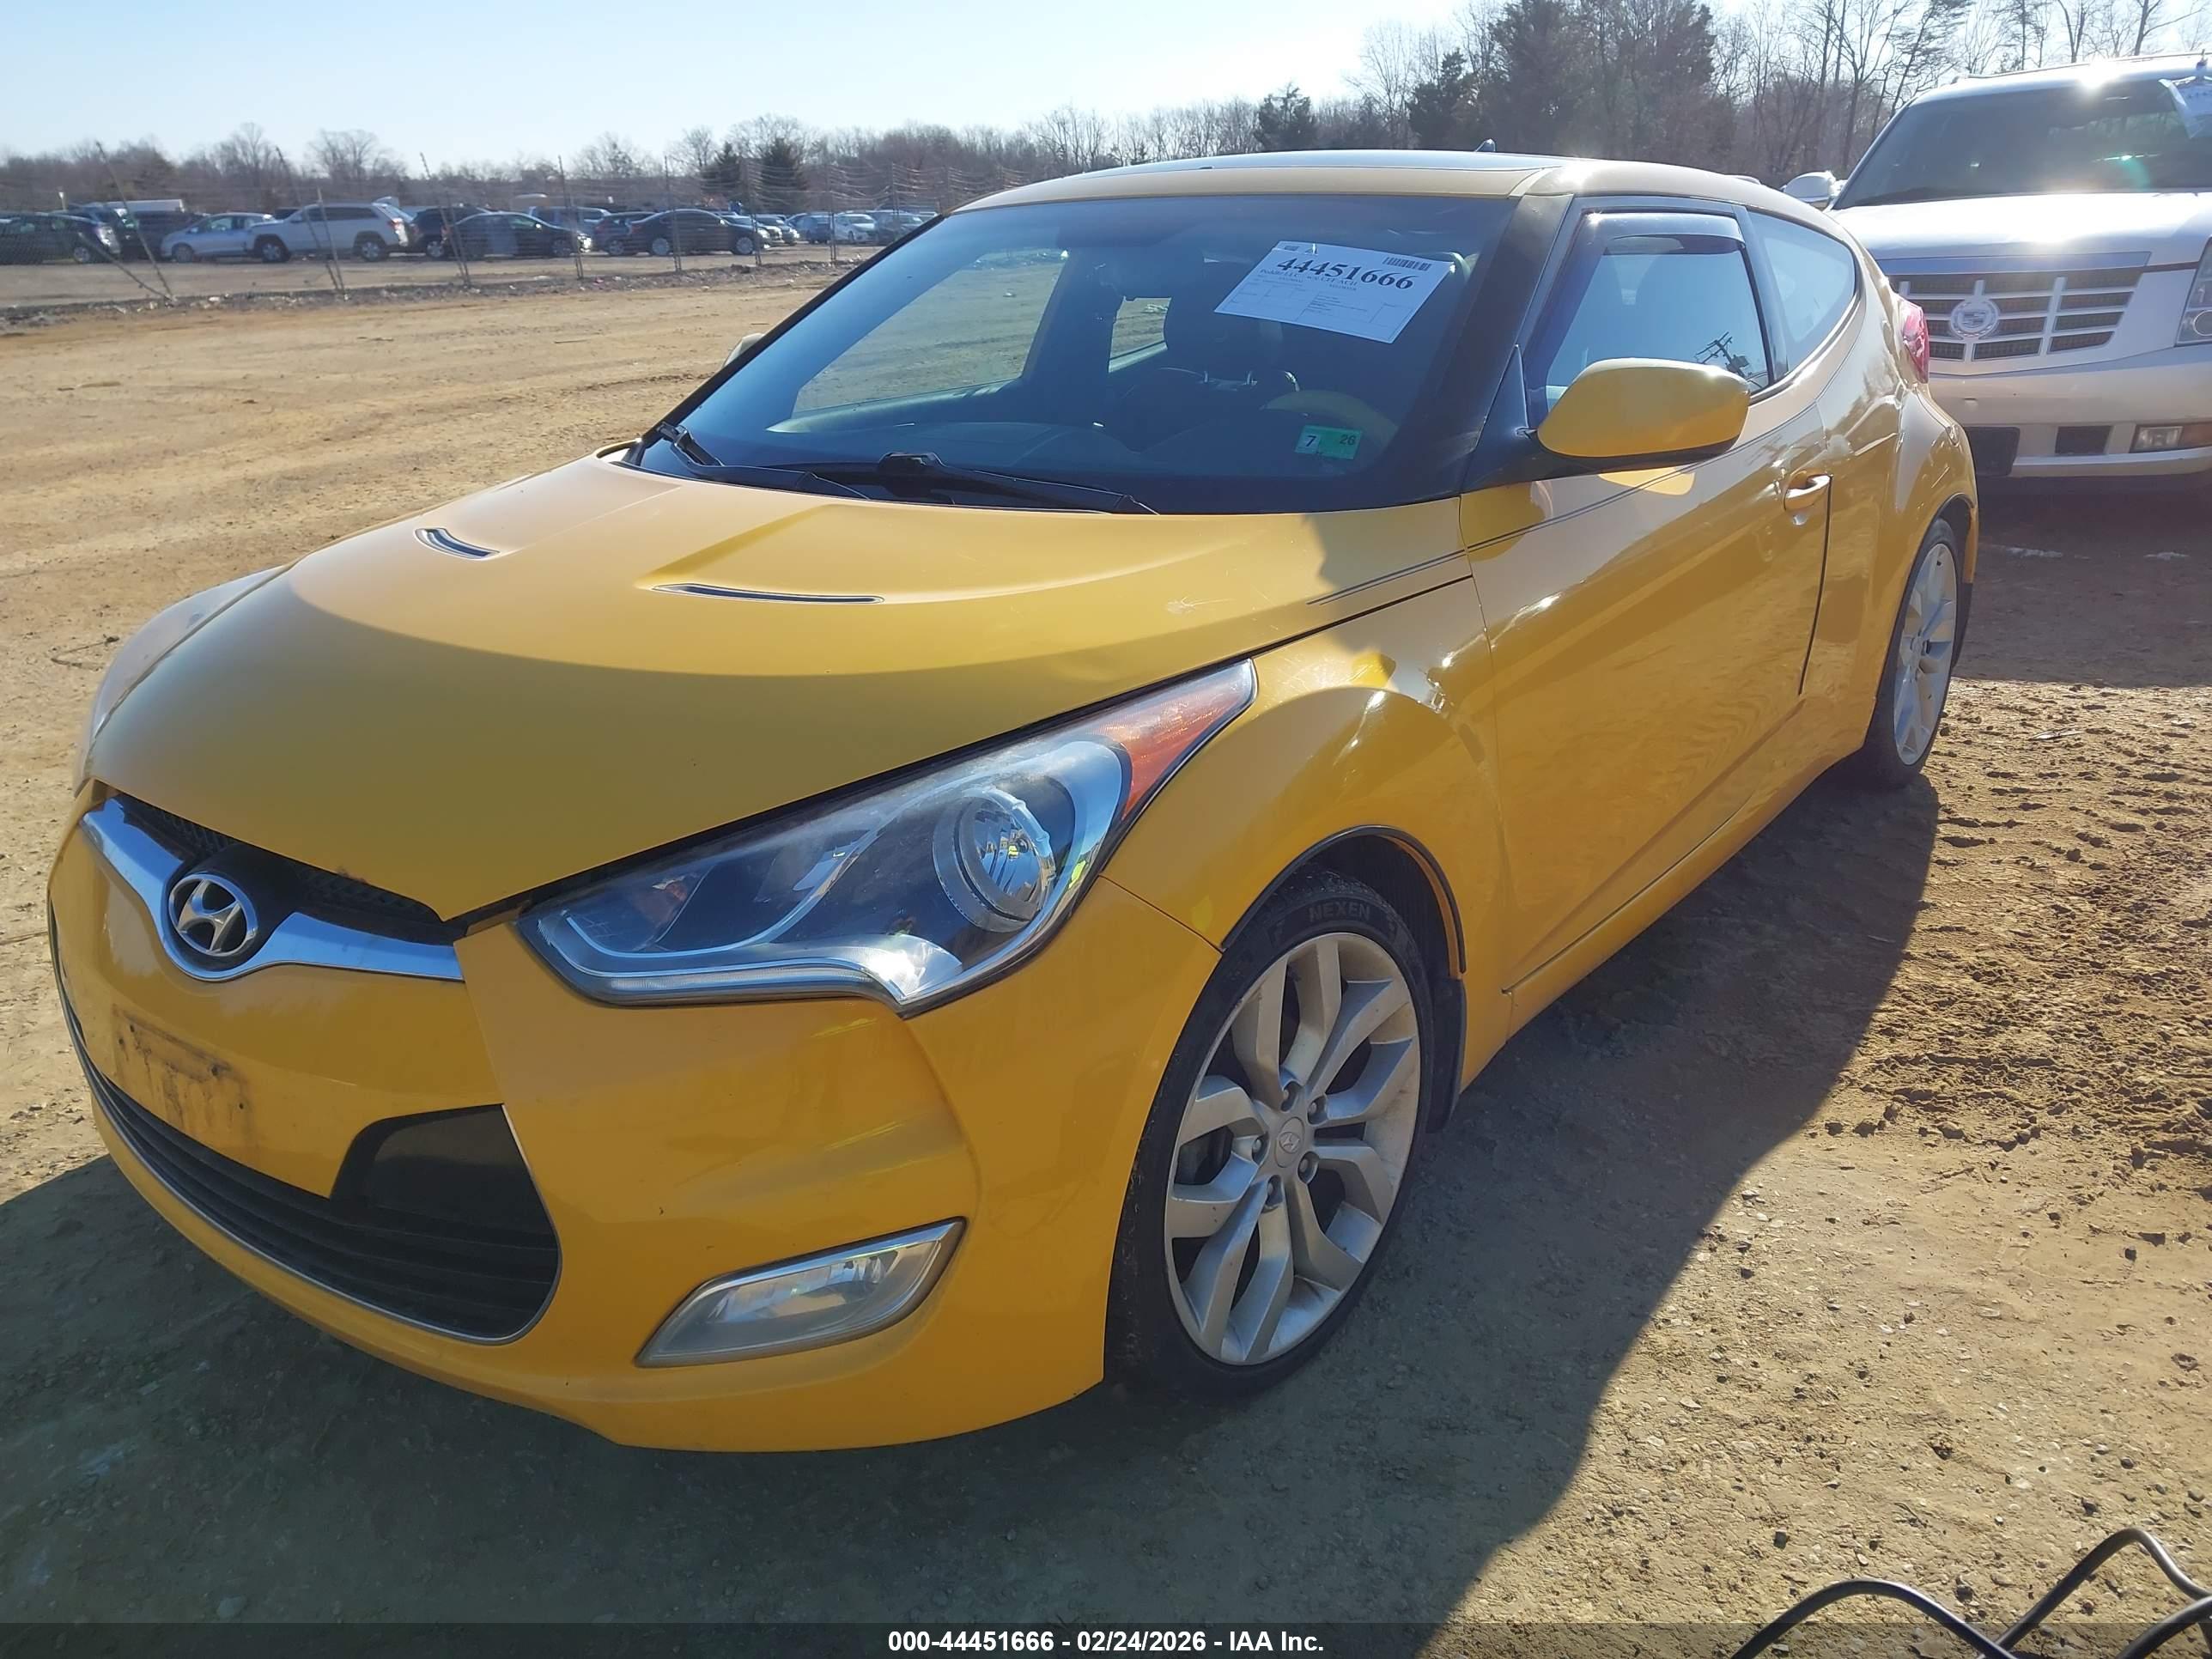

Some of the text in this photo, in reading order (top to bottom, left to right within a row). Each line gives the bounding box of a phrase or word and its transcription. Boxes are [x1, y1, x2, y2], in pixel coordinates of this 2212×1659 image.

[1277, 258, 1418, 289] 44451666
[1305, 434, 1317, 447] 7
[1309, 902, 1370, 922] NEXEN
